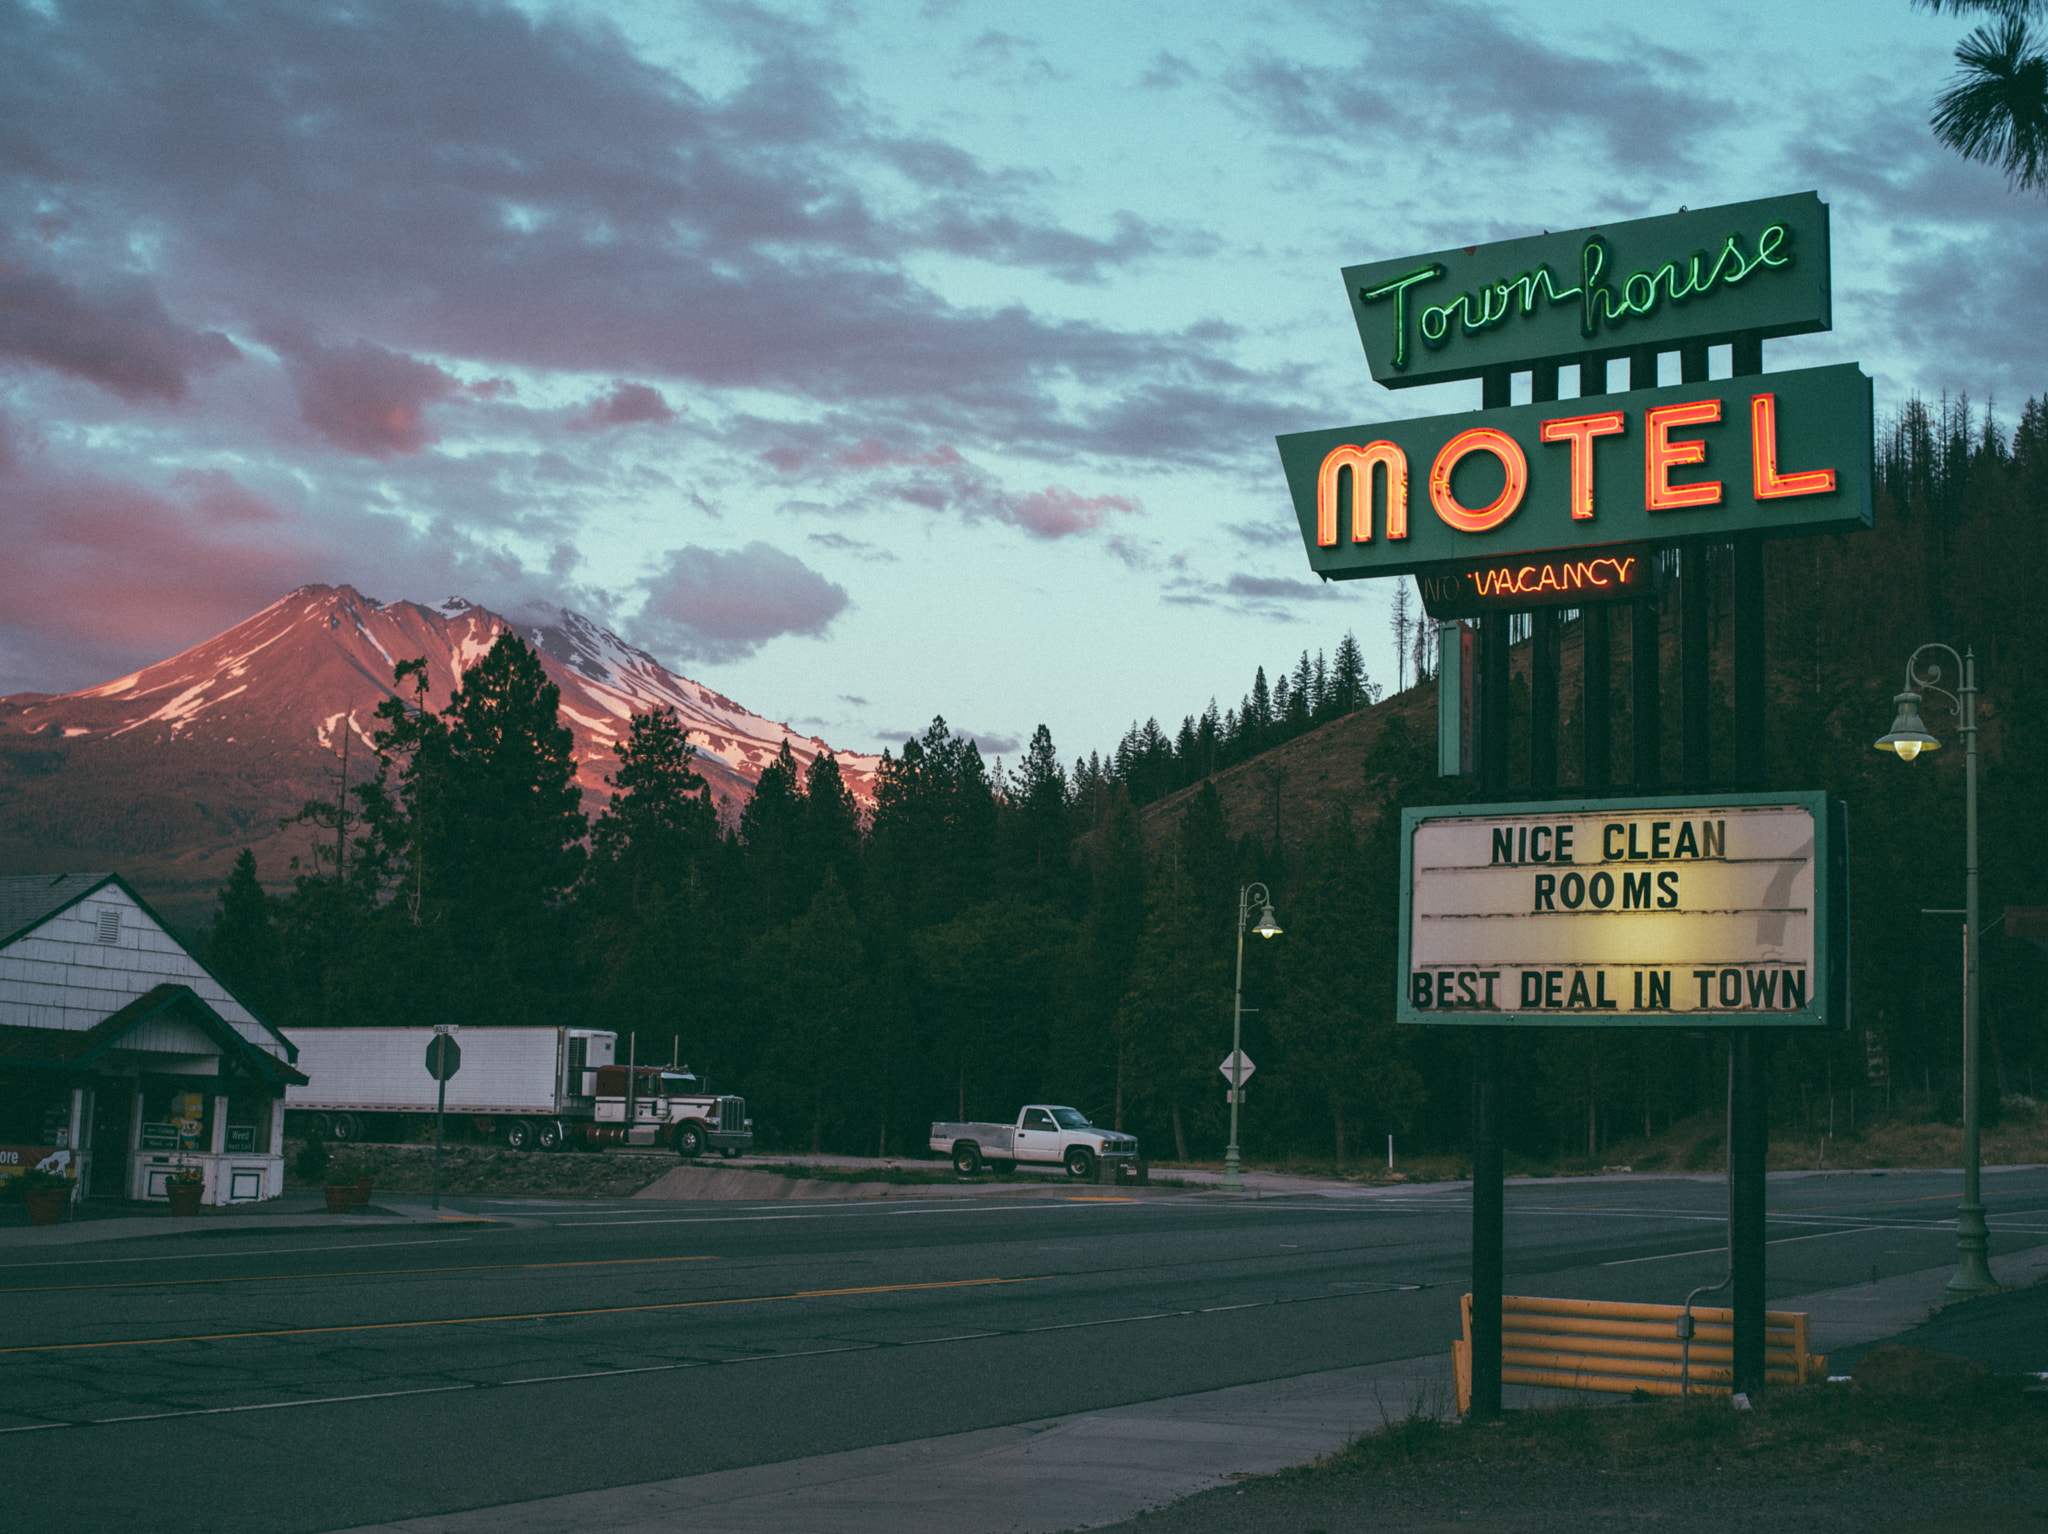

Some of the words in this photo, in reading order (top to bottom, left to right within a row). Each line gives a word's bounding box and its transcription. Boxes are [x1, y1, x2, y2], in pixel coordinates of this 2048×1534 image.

[1359, 220, 1794, 373] Townhouse
[1316, 392, 1836, 548] MOTEL
[1424, 575, 1460, 602] NO
[1467, 557, 1636, 596] VACANCY
[1491, 825, 1574, 864] NICE
[1603, 820, 1726, 860] CLEAN
[1534, 871, 1679, 911] ROOMS
[1411, 970, 1500, 1009] BEST
[1520, 970, 1617, 1008] DEAL
[1634, 970, 1672, 1008] IN
[1693, 968, 1806, 1009] TOWN
